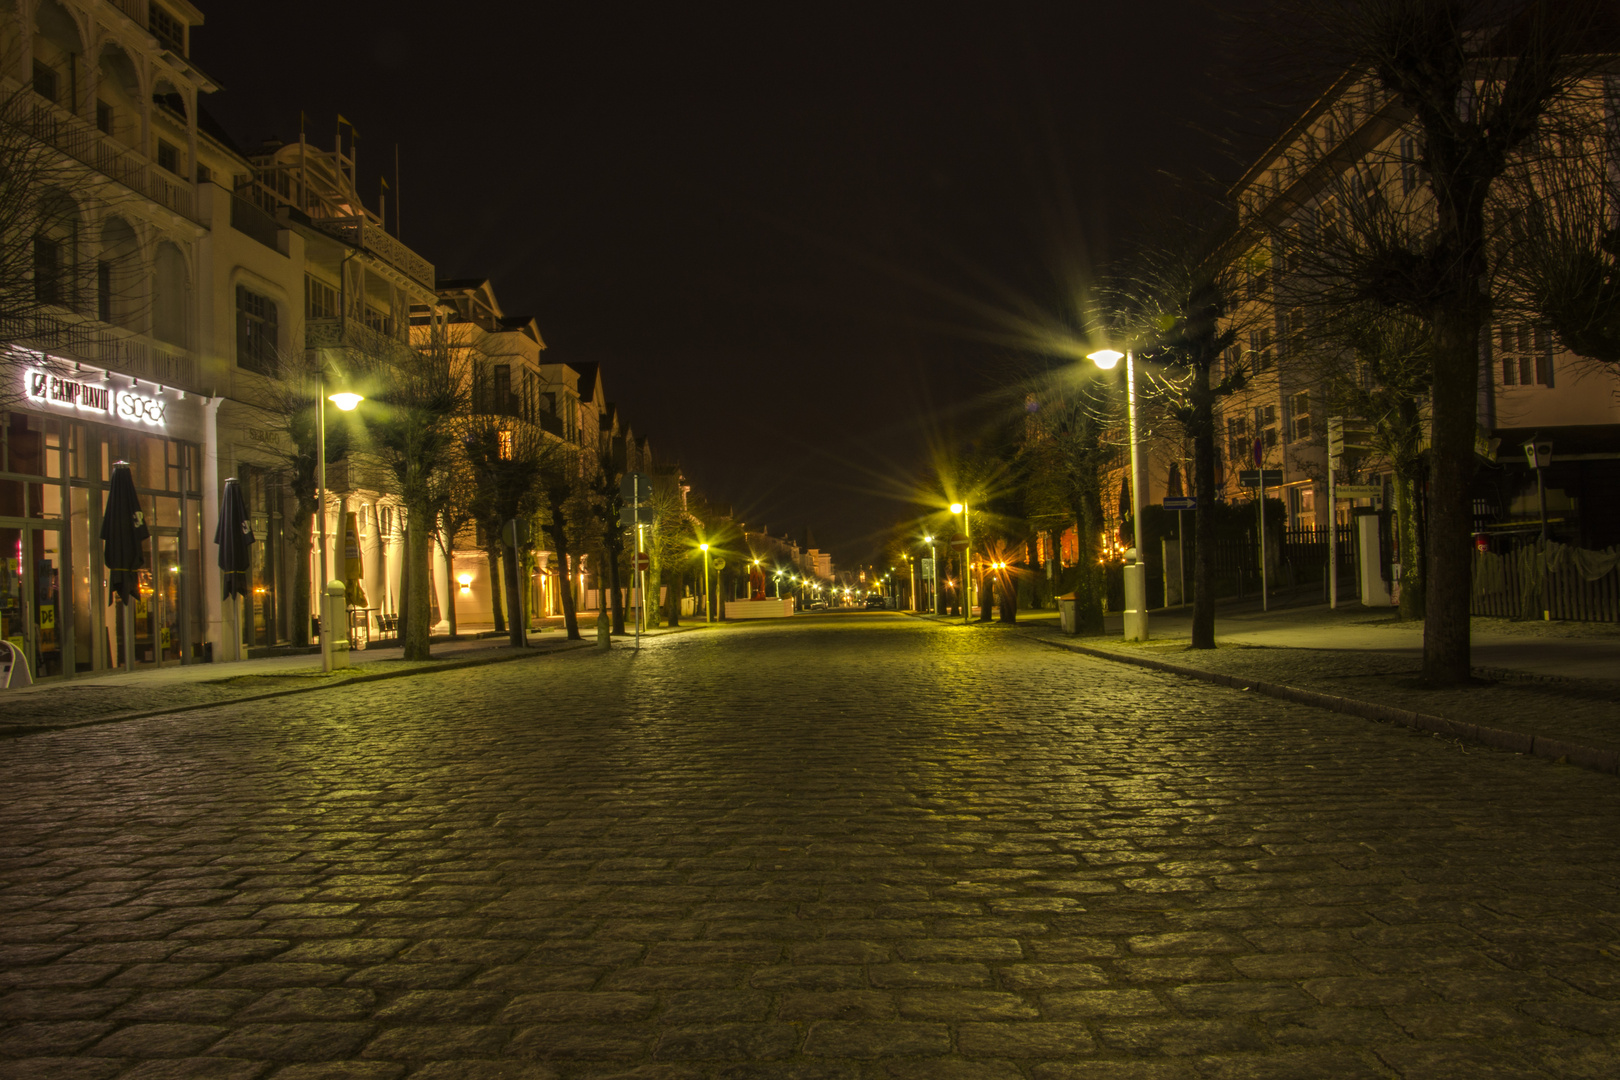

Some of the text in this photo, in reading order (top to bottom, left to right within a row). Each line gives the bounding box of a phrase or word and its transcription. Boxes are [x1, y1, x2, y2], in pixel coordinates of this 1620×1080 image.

[51, 377, 109, 410] CAMP DAVID
[249, 428, 280, 445] SEBAGO
[41, 609, 53, 624] DE
